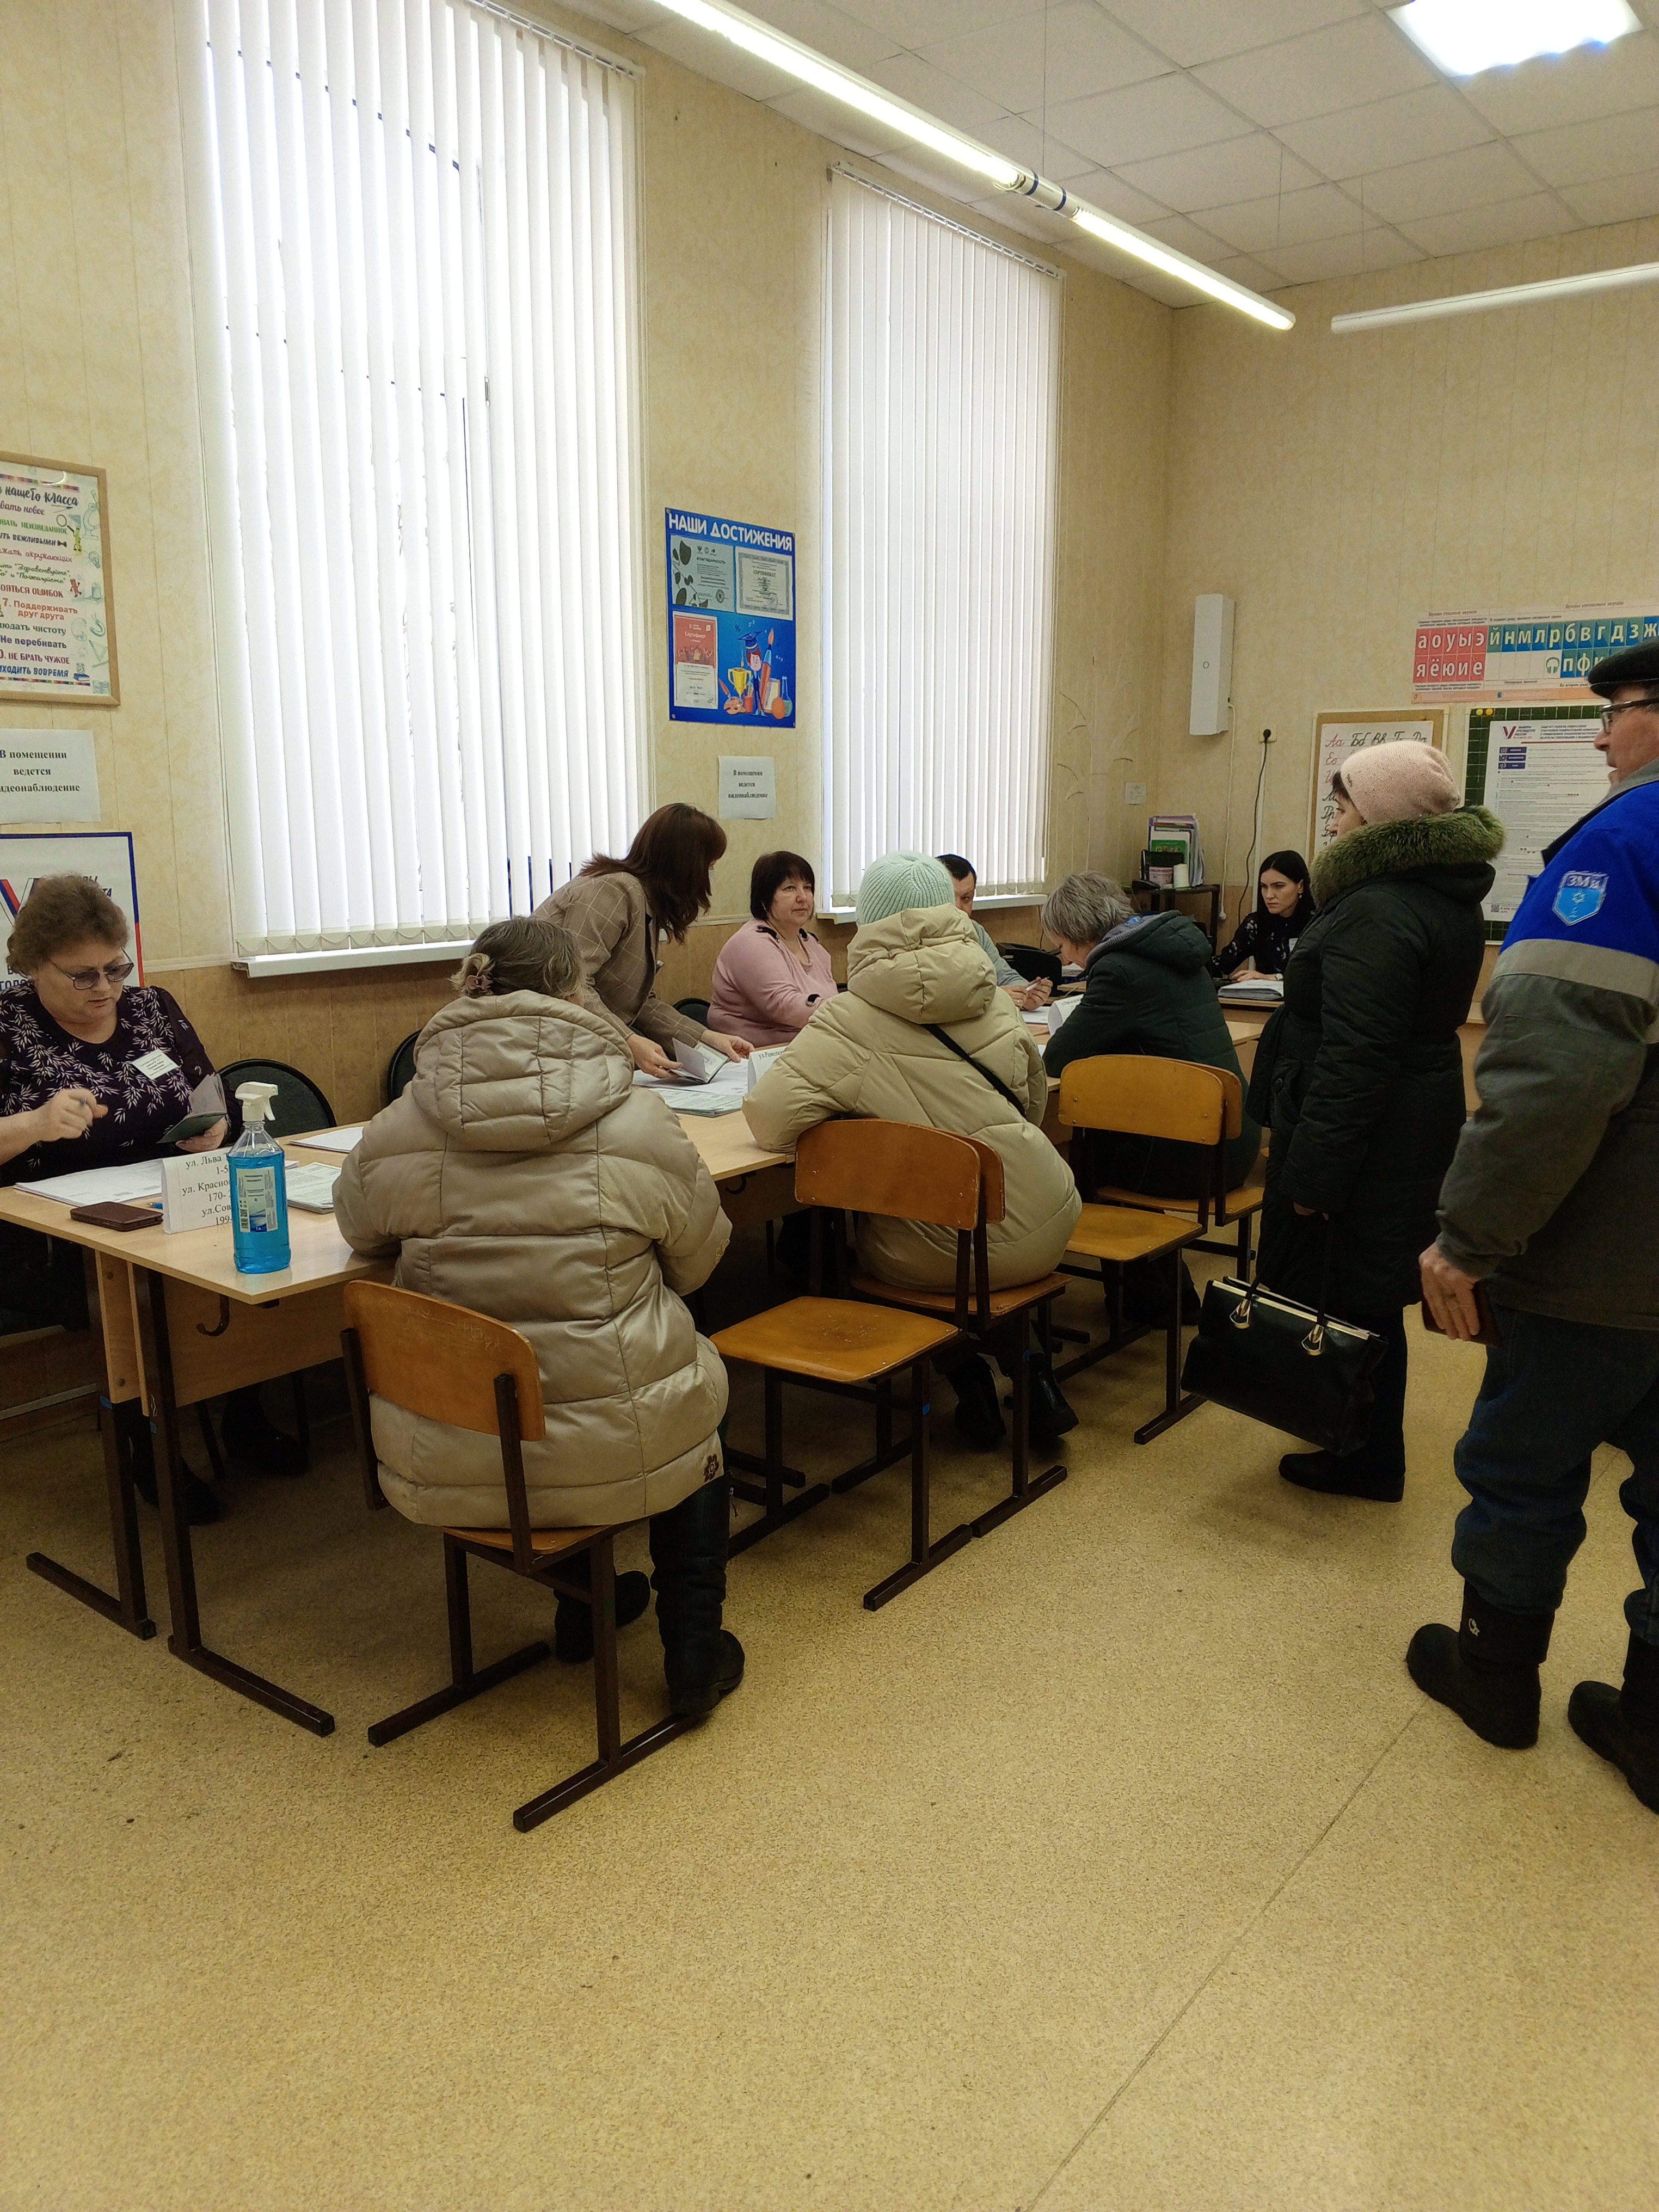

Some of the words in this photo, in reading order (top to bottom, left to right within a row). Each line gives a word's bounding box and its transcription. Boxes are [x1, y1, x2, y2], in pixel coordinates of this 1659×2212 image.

[5, 486, 41, 501] нашего
[44, 492, 78, 506] класса
[24, 506, 45, 515] новое
[669, 513, 707, 535] НАШИ
[710, 521, 792, 551] ДОСТИЖЕНИЯ
[13, 534, 56, 546] ВЕЖЛИВЫМИ
[25, 551, 72, 562] окружающих
[32, 588, 63, 598] ОШИБОК
[2, 598, 11, 607] 7.
[14, 600, 78, 614] Поддерживать
[18, 610, 38, 618] друг
[40, 612, 64, 620] друга
[33, 625, 66, 636] чистоту
[0, 635, 12, 643] Не
[15, 637, 67, 649] перебивать
[20, 653, 42, 662] БРАТЬ
[44, 655, 70, 664] ЧУЖОЕ
[34, 667, 69, 677] ВОВРЕМЯ
[0, 749, 6, 758] В
[9, 751, 67, 759] помещении
[13, 768, 51, 776] ведется
[185, 1160, 199, 1170] ул.
[201, 1156, 222, 1165] Льва
[182, 1187, 195, 1196] ул.
[198, 1179, 231, 1192] Красно
